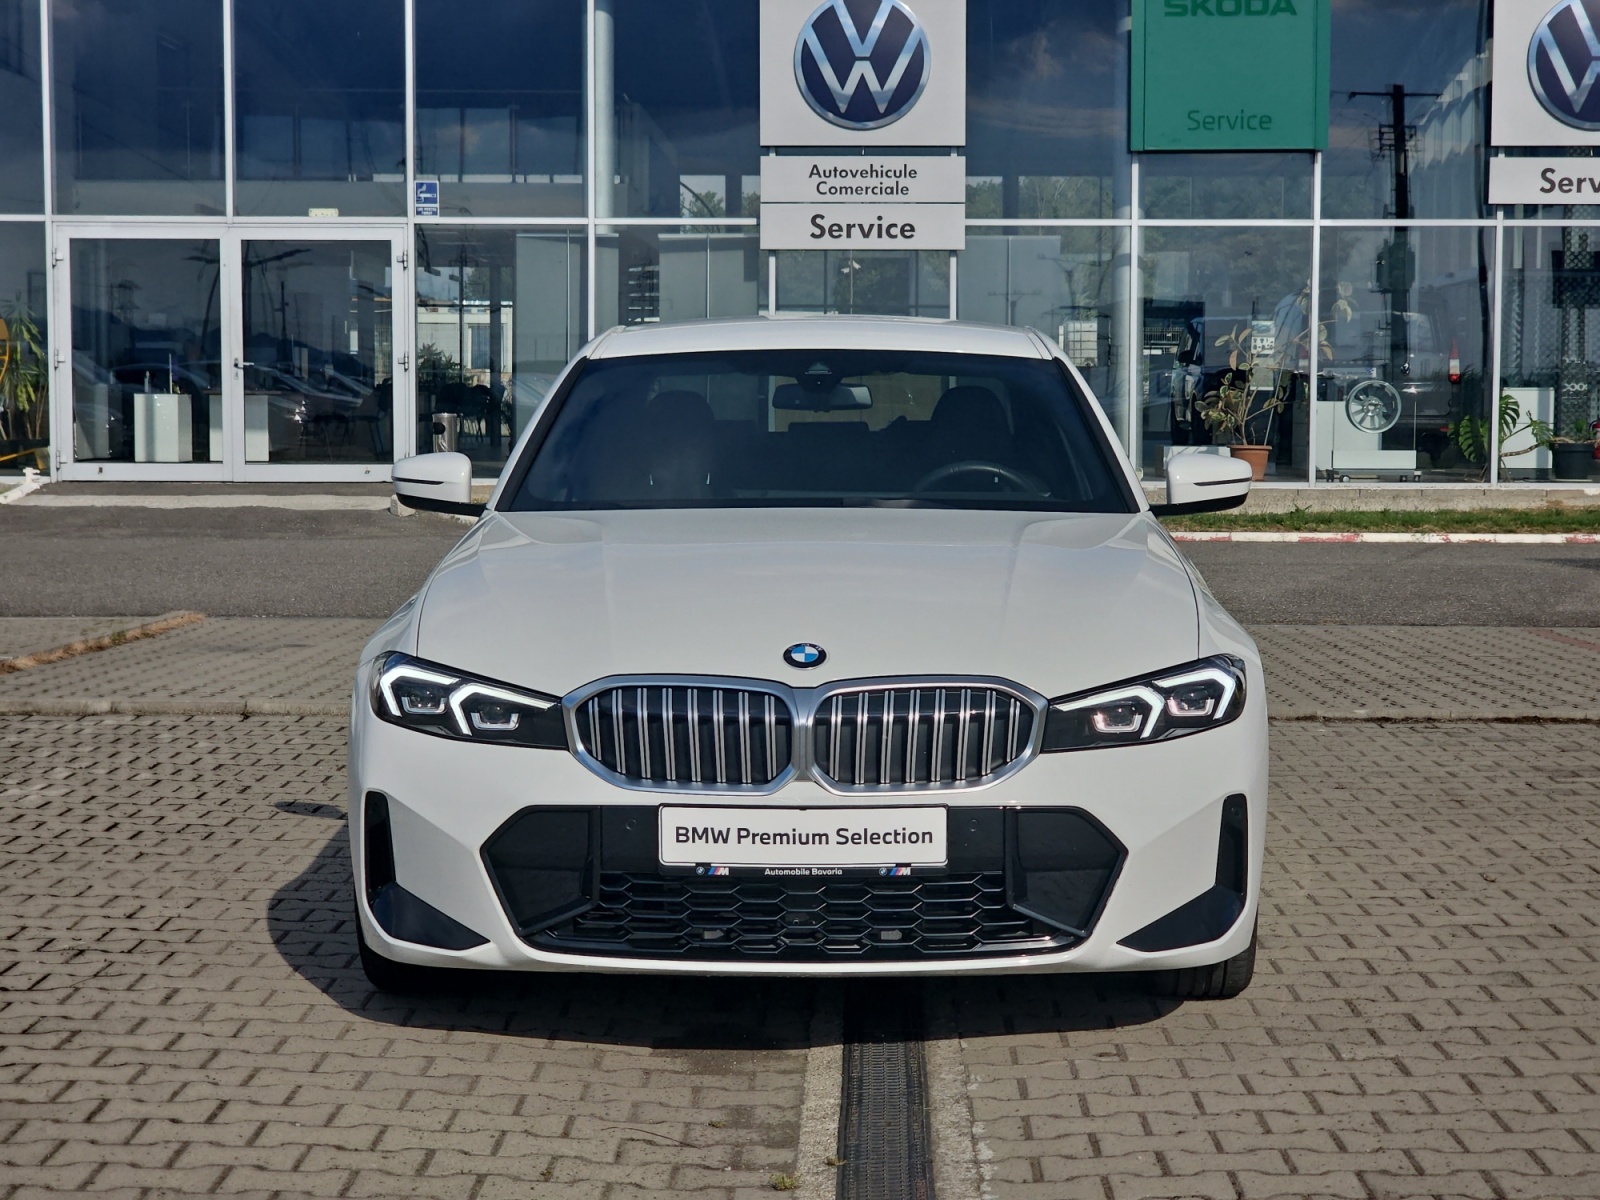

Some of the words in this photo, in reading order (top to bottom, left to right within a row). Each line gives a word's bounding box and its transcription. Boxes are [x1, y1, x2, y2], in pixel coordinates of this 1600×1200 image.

[1187, 109, 1273, 131] Service
[808, 163, 918, 179] Autovehicule
[816, 180, 910, 196] Comerciale
[809, 213, 916, 240] Service
[675, 826, 731, 844] BMW
[736, 827, 830, 845] Premium
[835, 827, 933, 846] Selection
[764, 868, 810, 876] Automobile
[811, 867, 843, 876] Bavaria
